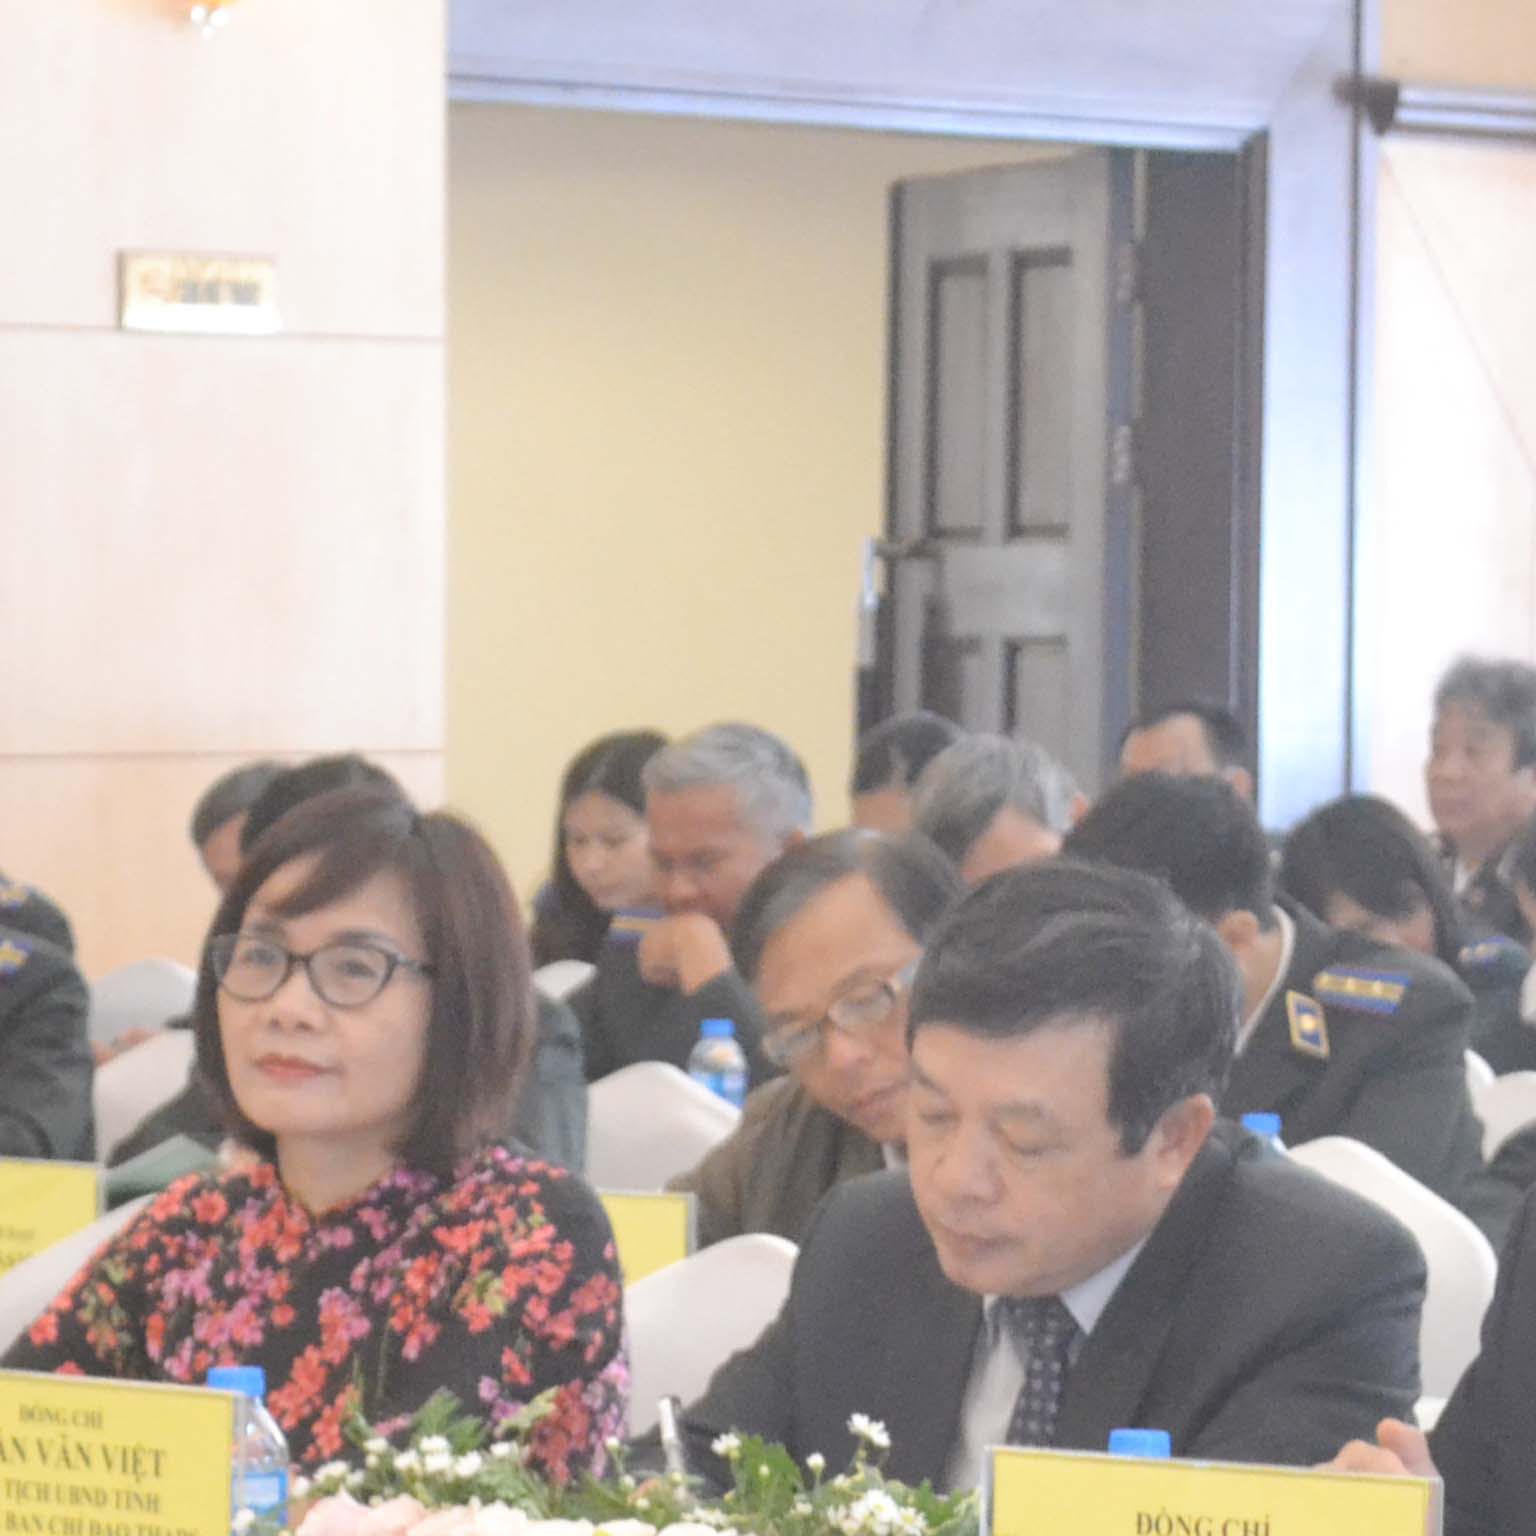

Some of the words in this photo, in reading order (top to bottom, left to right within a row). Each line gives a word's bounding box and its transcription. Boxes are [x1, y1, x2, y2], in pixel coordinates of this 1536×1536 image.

[72, 1407, 104, 1430] CHÍ
[35, 1433, 92, 1471] VĂN
[100, 1442, 167, 1483] VIỆT
[4, 1479, 51, 1506] TỊCH
[54, 1483, 108, 1509] UBND
[114, 1486, 161, 1514] TỈNH
[6, 1511, 45, 1534] BAN
